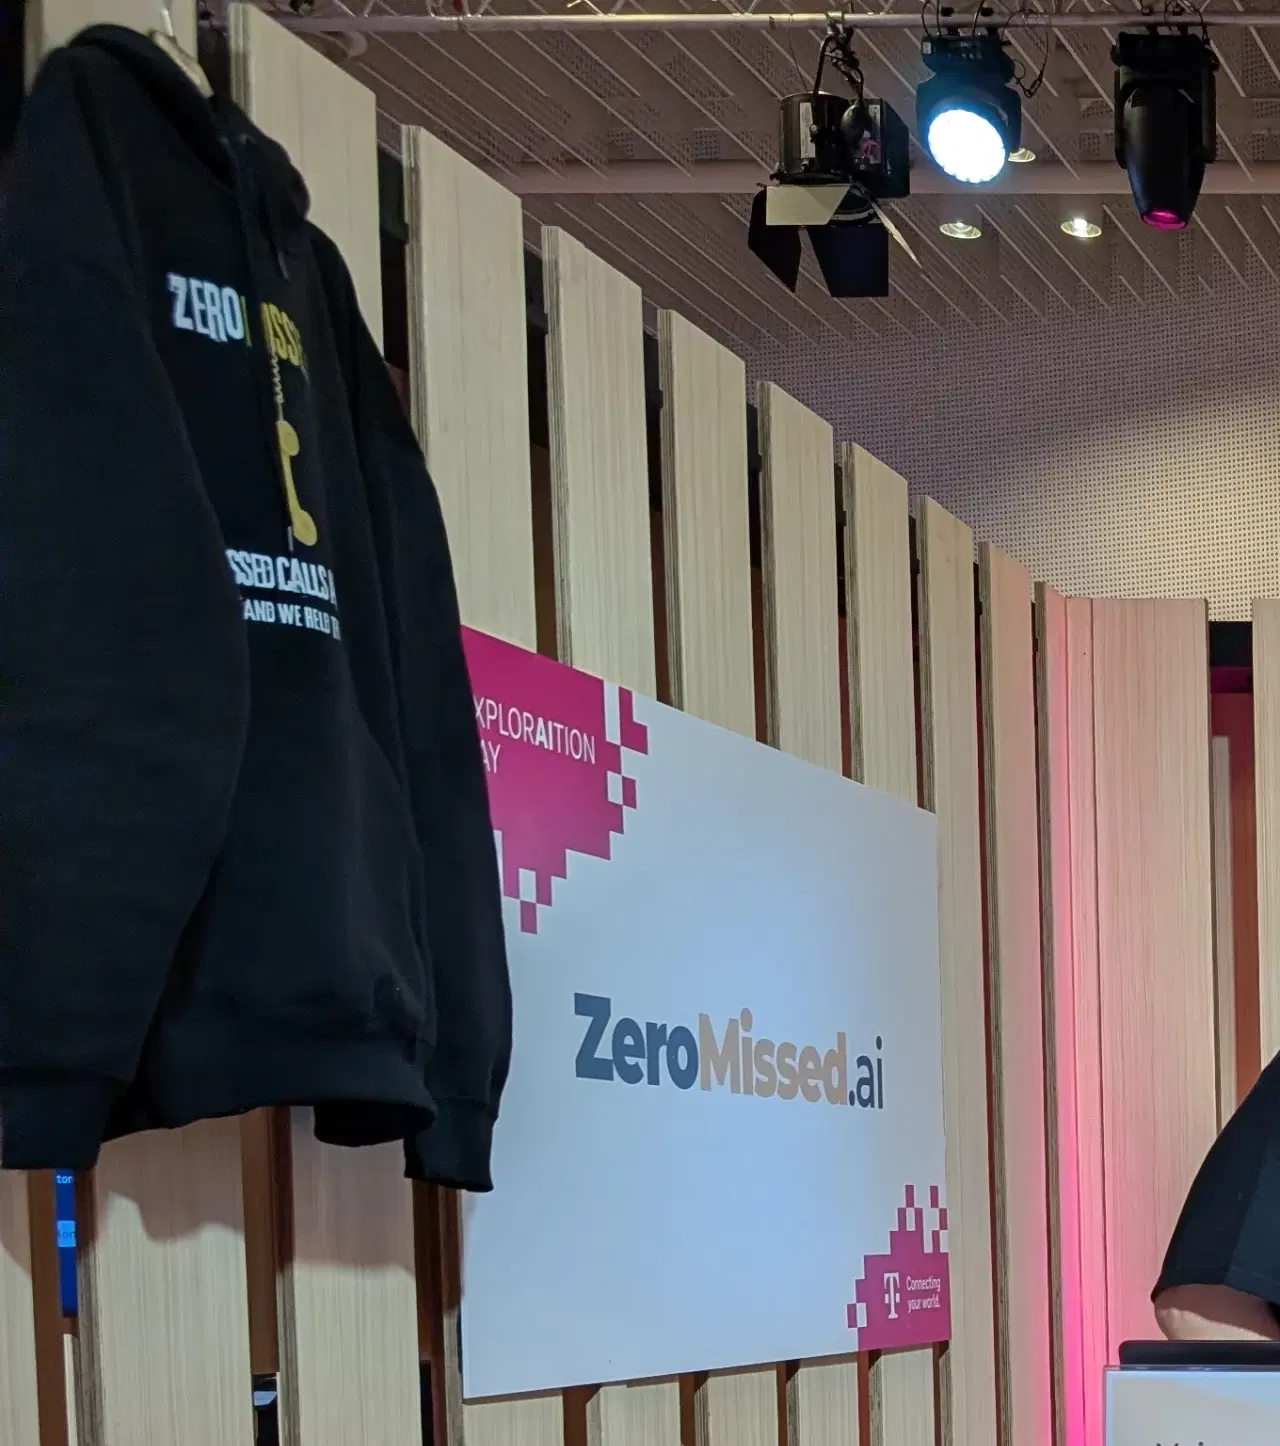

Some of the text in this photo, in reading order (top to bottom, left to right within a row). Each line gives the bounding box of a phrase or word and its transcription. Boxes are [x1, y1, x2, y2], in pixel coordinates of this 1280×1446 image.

[276, 556, 330, 601] CALLS
[277, 602, 303, 627] WE
[304, 606, 331, 634] HELD
[473, 695, 596, 764] XPLORAITION
[480, 739, 501, 773] AY
[574, 992, 884, 1109] ZeroMissed.ai
[906, 1275, 941, 1292] Connecting
[907, 1299, 921, 1314] your
